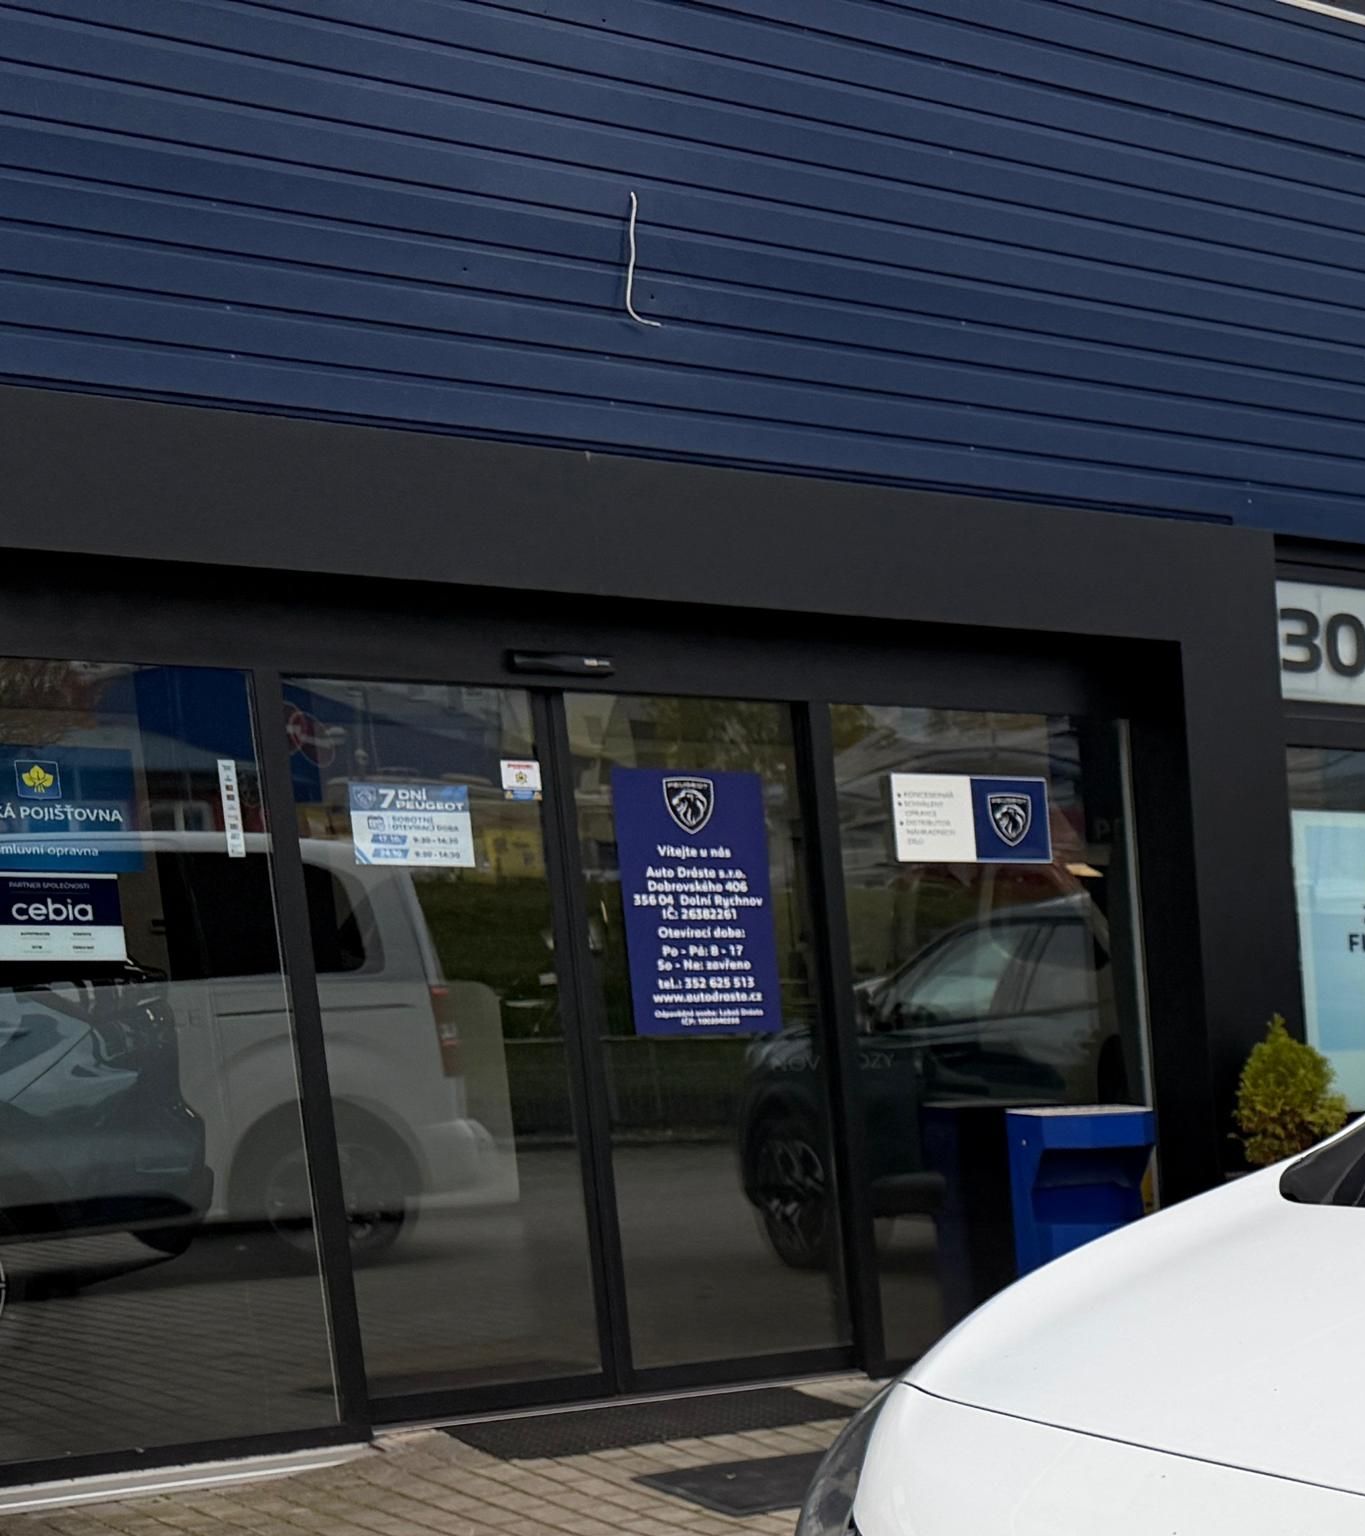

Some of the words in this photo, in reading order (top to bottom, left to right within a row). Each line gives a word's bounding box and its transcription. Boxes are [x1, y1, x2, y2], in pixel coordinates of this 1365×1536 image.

[378, 788, 396, 809] 7
[397, 787, 427, 800] DNÍ
[396, 801, 465, 811] PEUGEOT
[20, 804, 123, 822] POJIŠŤOVNA
[47, 845, 99, 857] opravna
[657, 844, 697, 859] Vítejte
[700, 848, 707, 857] u
[710, 845, 731, 858] nás
[646, 866, 674, 878] Auto
[719, 869, 747, 879] s.r.o.
[648, 880, 723, 893] Dobrovského
[725, 881, 748, 893] 406
[633, 894, 656, 906] 356
[658, 894, 674, 906] 04
[680, 895, 711, 906] Dolní
[714, 895, 763, 909] Rychnov
[11, 897, 94, 921] cebia
[658, 926, 712, 938] Otevírací
[714, 926, 746, 938] doba:
[662, 945, 679, 957] Po
[729, 944, 744, 956] 17
[657, 959, 672, 971] So
[706, 958, 752, 971] zavřeno
[685, 977, 706, 989] 352
[709, 976, 731, 989] 625
